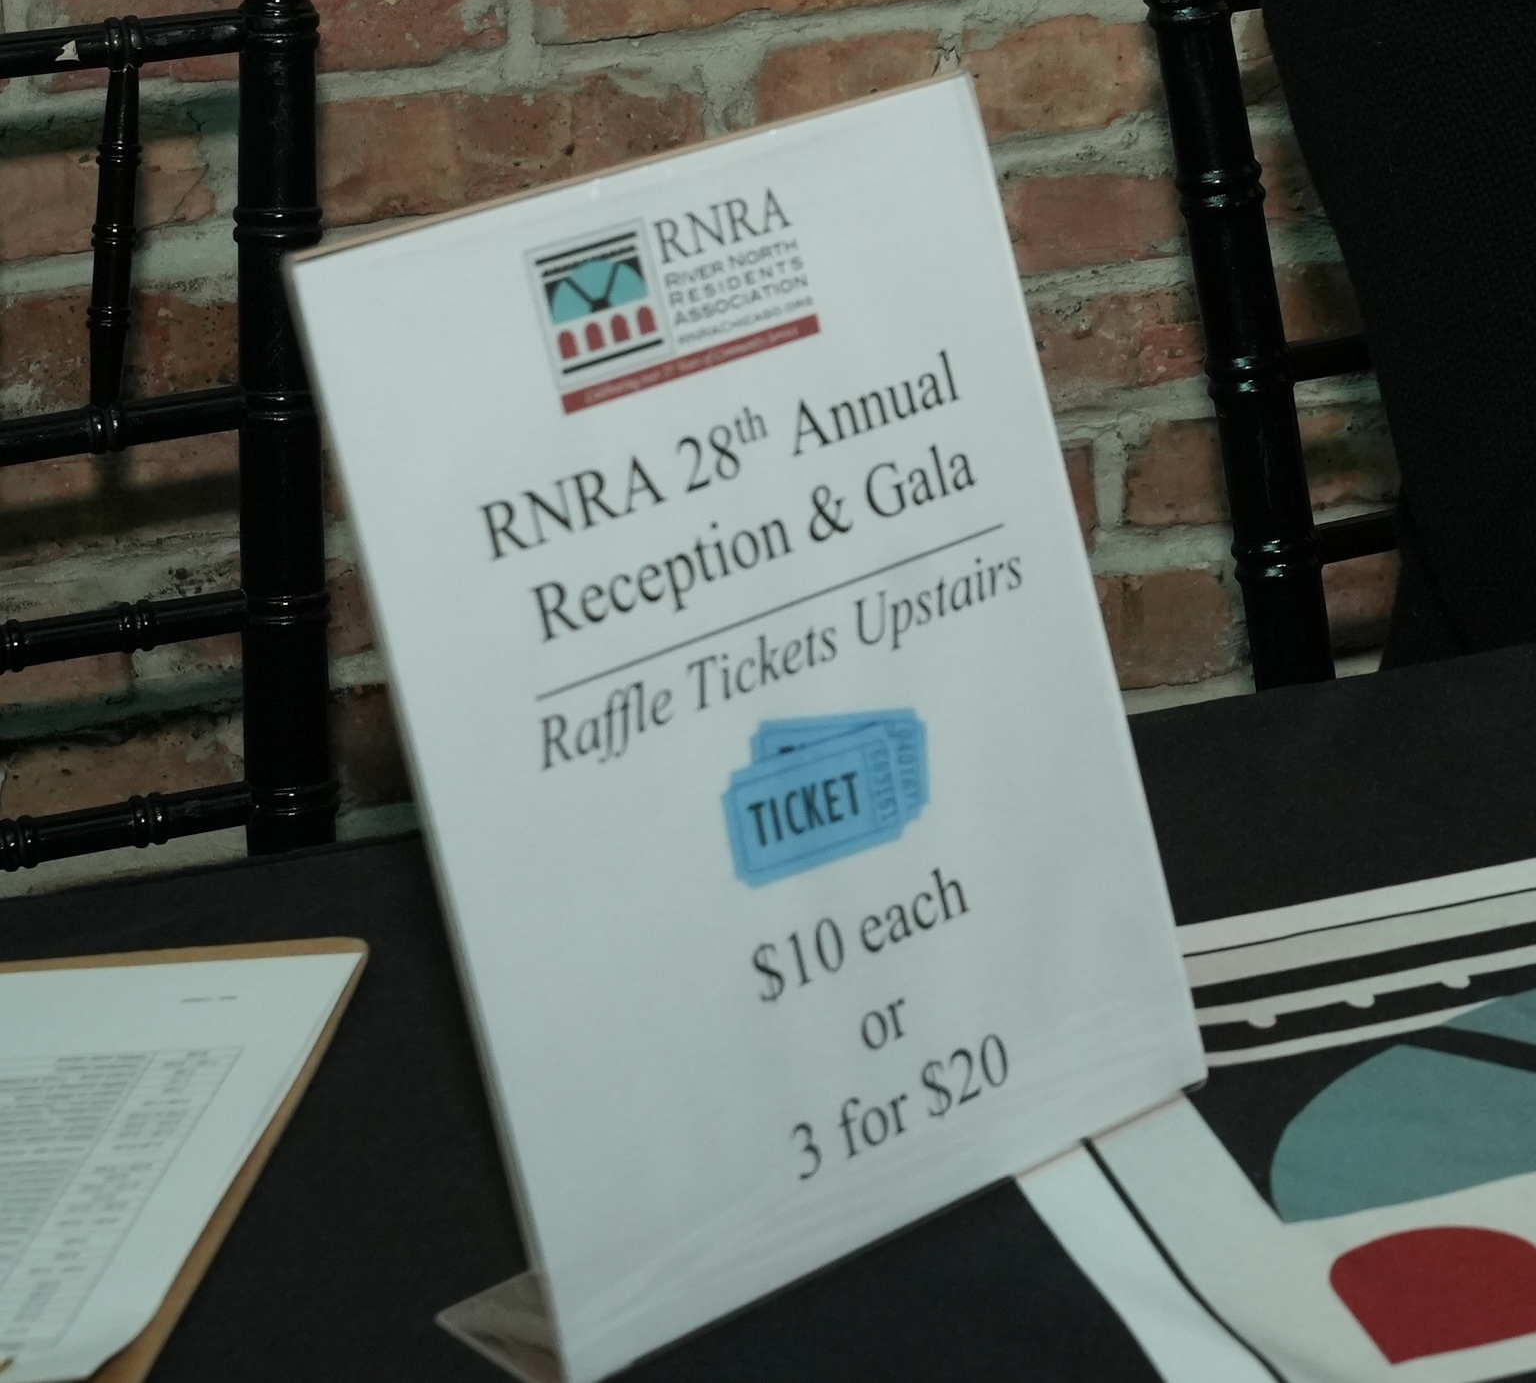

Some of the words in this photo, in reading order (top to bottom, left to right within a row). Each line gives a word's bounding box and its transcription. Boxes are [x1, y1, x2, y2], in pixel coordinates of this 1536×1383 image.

[653, 188, 792, 265] RNRA
[663, 260, 724, 288] RIVER
[728, 238, 799, 267] NORTH
[669, 255, 804, 307] RESIDENTS
[674, 273, 809, 326] ASSOCIATION
[479, 456, 667, 560] RNRA
[676, 406, 769, 494] 28th
[792, 349, 960, 456] Annual
[531, 518, 792, 642] Reception
[808, 484, 853, 544] &
[864, 444, 977, 519] Gala
[540, 681, 673, 770] Raffle
[686, 626, 838, 711] Tickets
[854, 556, 1022, 651] Upstairs
[746, 771, 860, 847] TICKET
[752, 918, 845, 1002] $10
[860, 868, 970, 955] each
[860, 998, 906, 1050] or
[792, 1122, 822, 1180] 3
[839, 1094, 909, 1159] for
[920, 1034, 1008, 1118] $20
